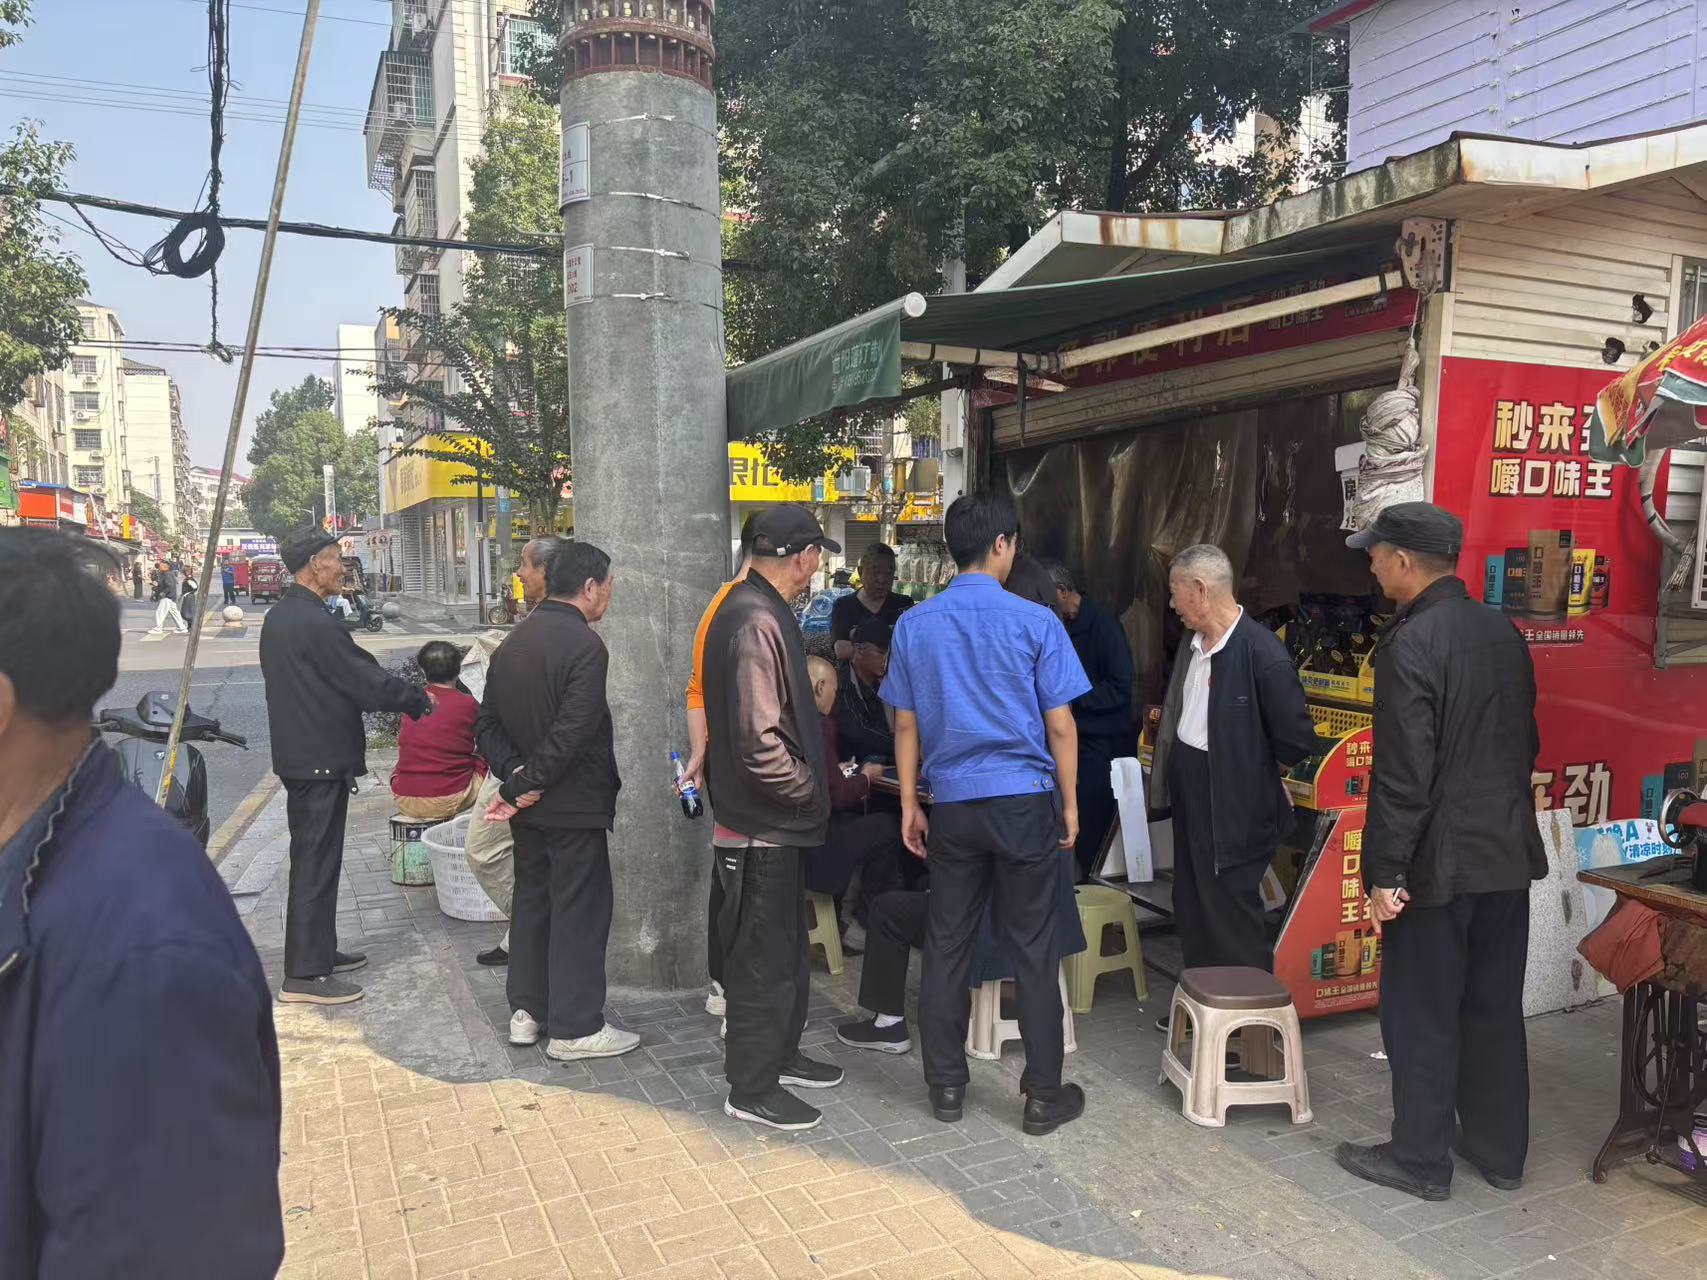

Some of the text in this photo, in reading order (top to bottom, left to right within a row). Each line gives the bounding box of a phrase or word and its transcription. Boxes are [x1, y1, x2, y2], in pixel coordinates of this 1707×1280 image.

[1490, 458, 1613, 497] 嚼口味王
[1341, 829, 1362, 923] 嚼口味王
